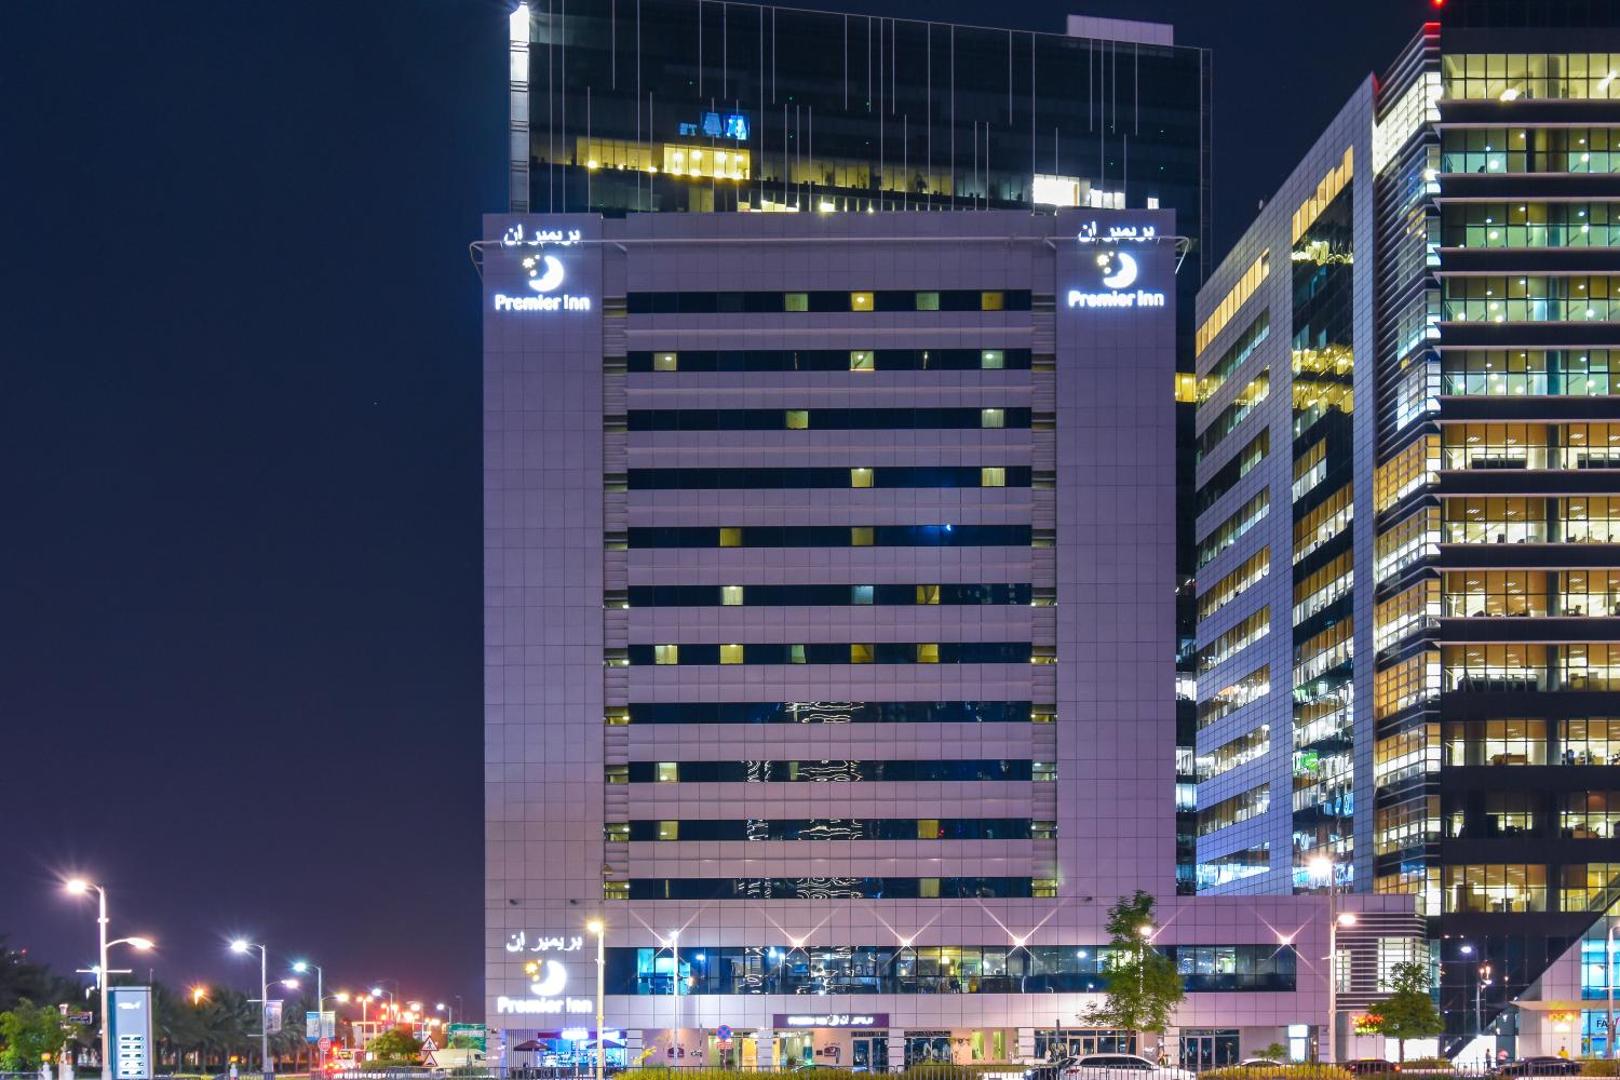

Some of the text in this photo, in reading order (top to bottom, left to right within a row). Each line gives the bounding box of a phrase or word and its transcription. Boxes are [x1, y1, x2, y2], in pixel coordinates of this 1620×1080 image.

[495, 294, 590, 310] Premier Inn
[1068, 290, 1164, 307] Premier Inn
[497, 996, 593, 1014] Premier Inn
